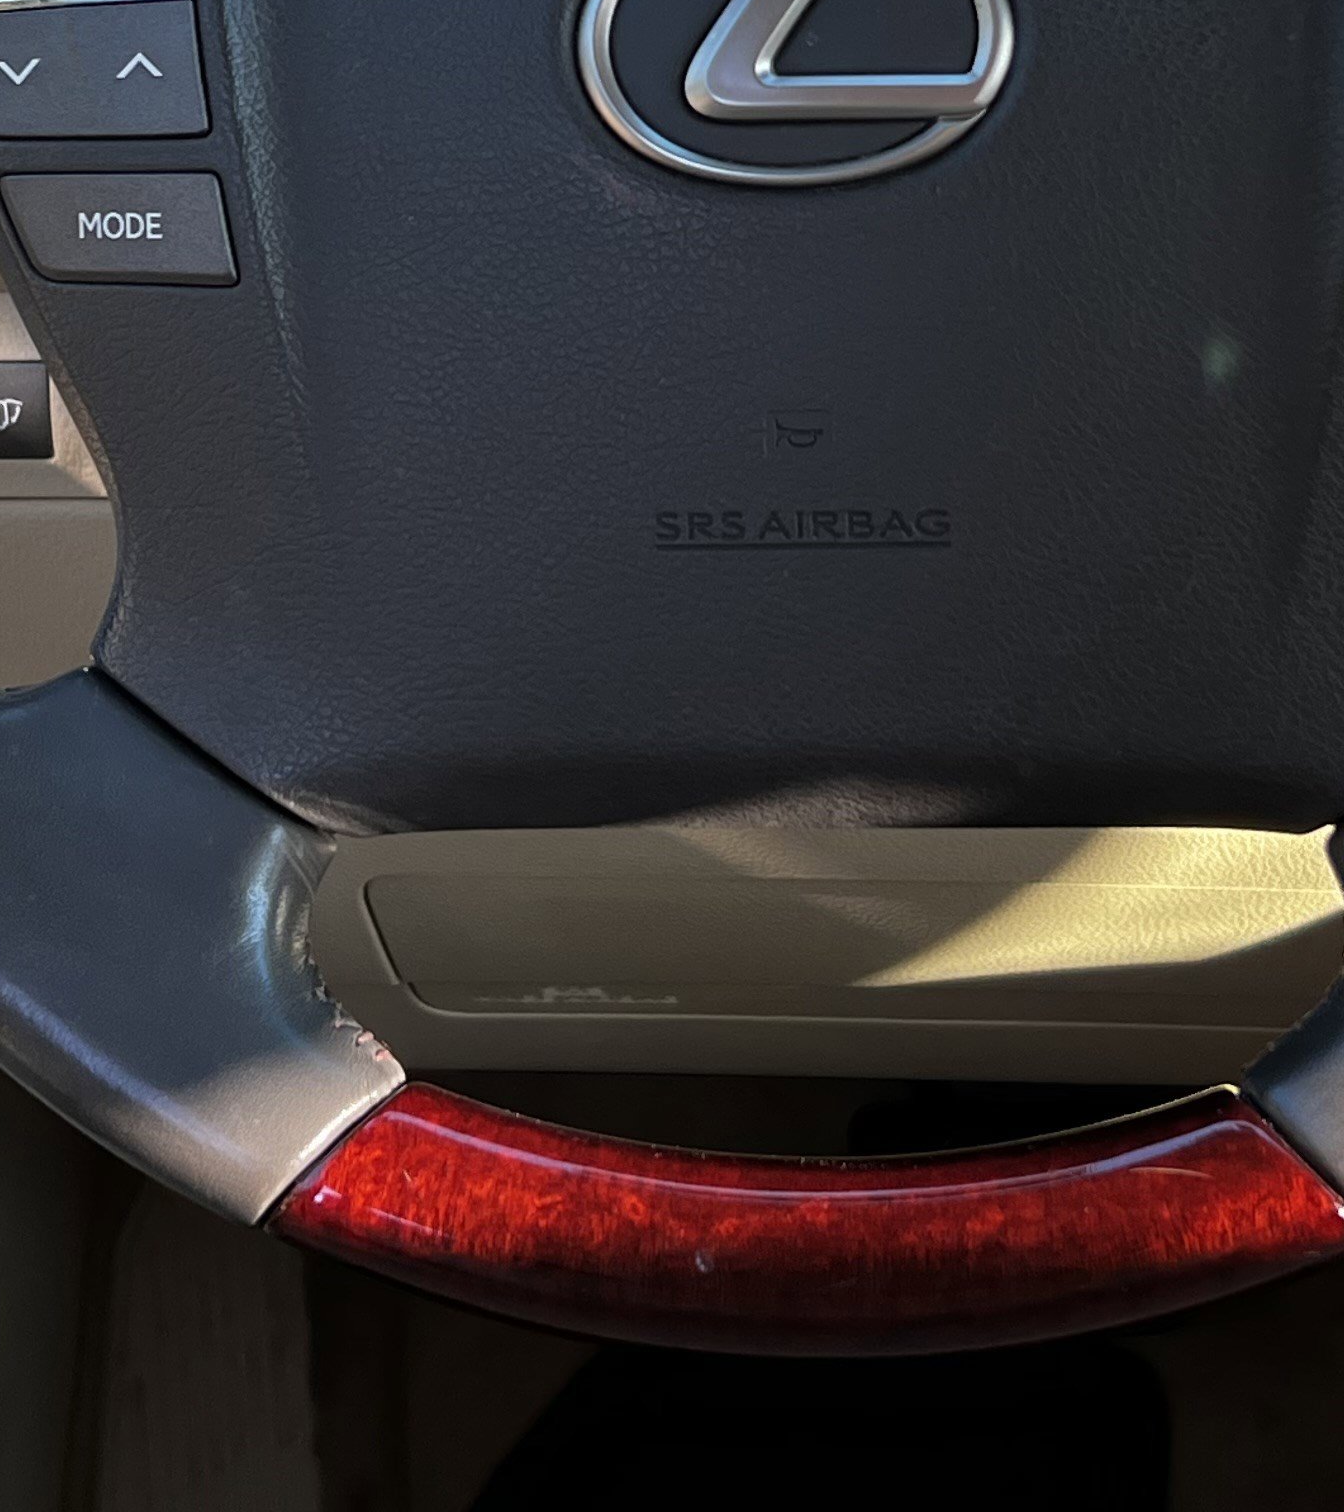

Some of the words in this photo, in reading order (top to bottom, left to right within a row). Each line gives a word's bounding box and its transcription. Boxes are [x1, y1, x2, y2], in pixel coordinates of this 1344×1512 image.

[78, 212, 163, 240] MODE
[655, 510, 746, 541] SRS
[759, 508, 952, 540] AIRBAG
